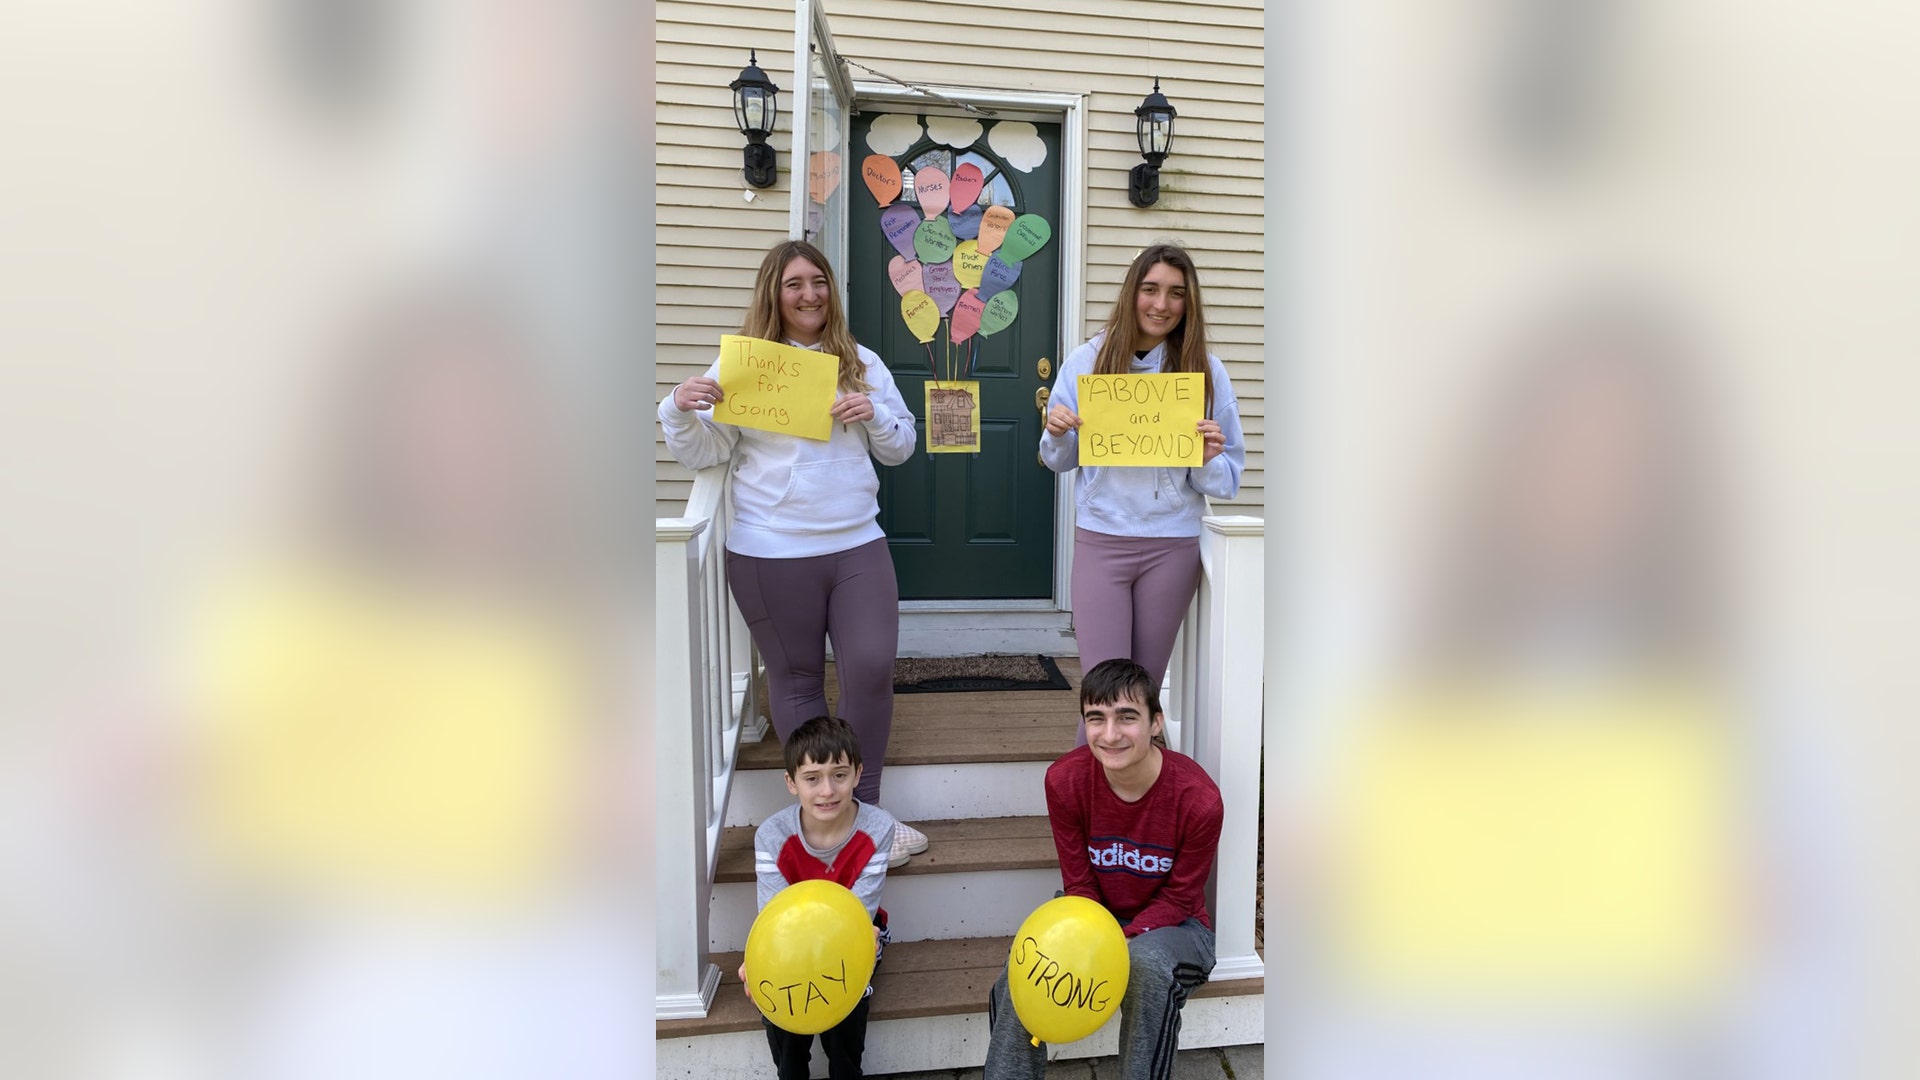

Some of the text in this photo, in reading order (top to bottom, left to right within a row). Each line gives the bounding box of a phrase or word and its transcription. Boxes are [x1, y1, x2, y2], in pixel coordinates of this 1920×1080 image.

[867, 167, 896, 186] Doctors
[918, 183, 943, 194] Nurses
[961, 252, 979, 261] Truck
[962, 262, 983, 271] Drivers
[905, 299, 929, 319] Farmers
[733, 340, 801, 377] Thanks
[756, 374, 789, 393] for
[1081, 377, 1190, 404] "ABOVE
[728, 393, 790, 426] Going
[1129, 411, 1160, 424] and
[1088, 843, 1173, 873] adidas
[1015, 937, 1111, 1012] STRONG
[759, 959, 848, 1016] STAY
